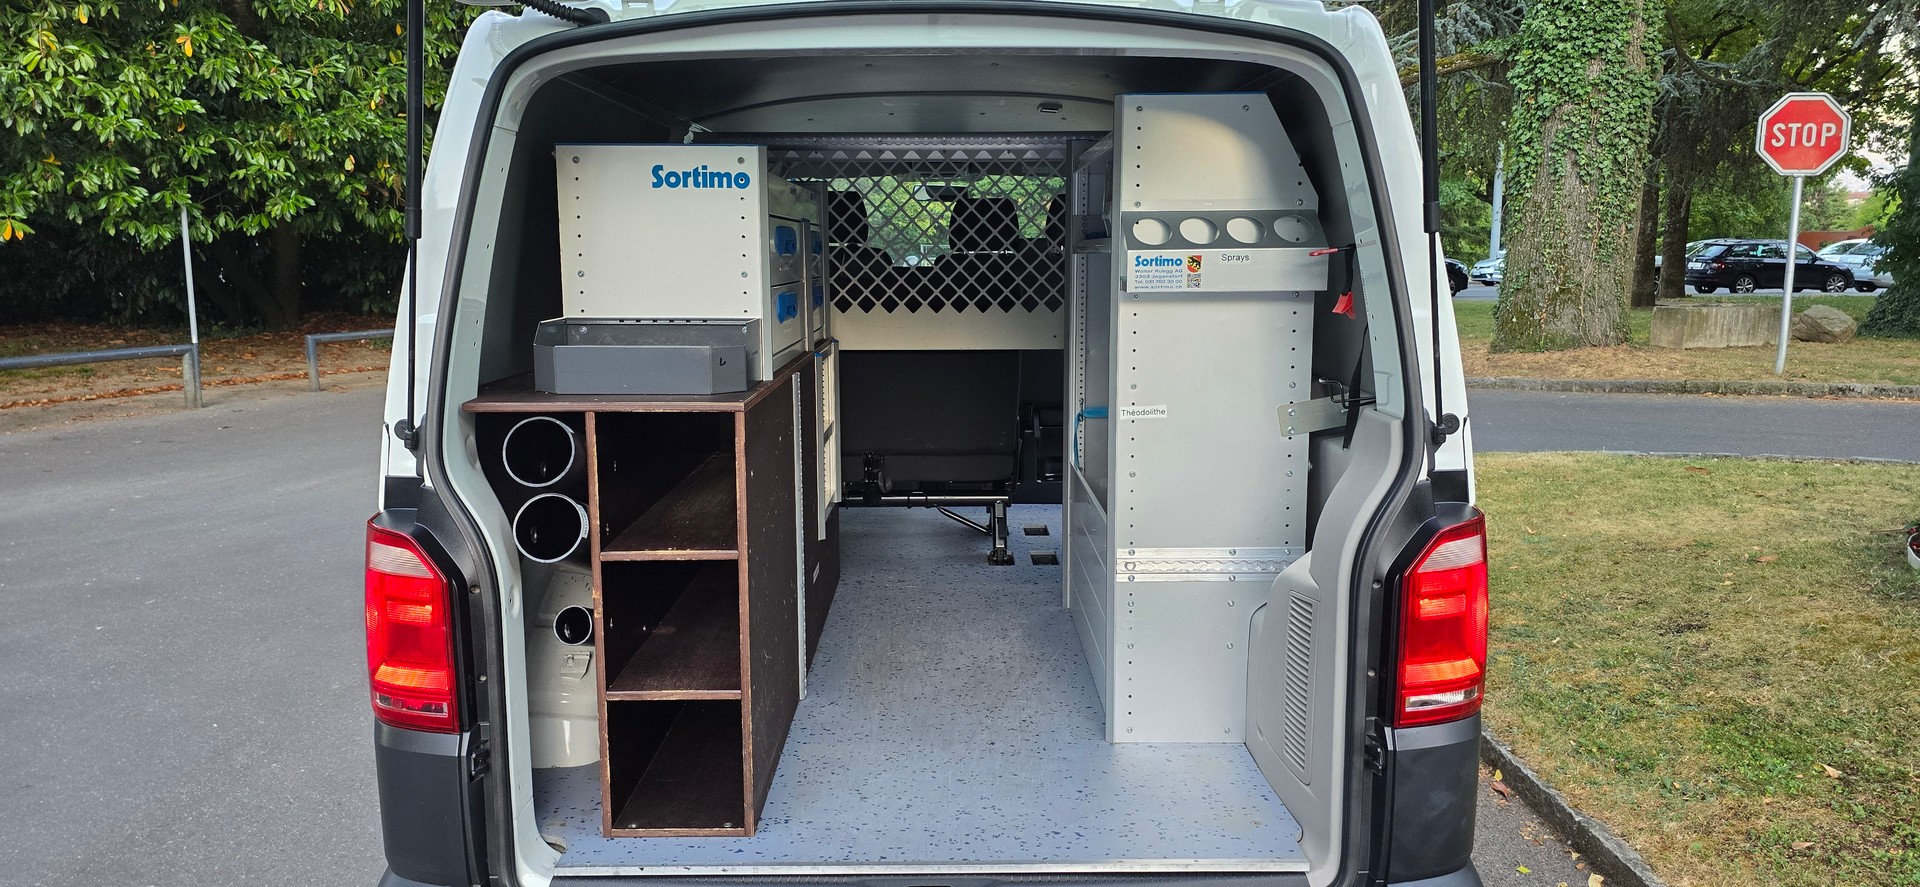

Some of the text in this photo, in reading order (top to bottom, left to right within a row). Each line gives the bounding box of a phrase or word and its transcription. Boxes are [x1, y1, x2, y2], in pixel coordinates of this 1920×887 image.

[1771, 122, 1837, 147] STOP
[651, 164, 751, 190] Sortimo
[1134, 255, 1183, 267] Sortimo
[1221, 253, 1250, 263] Sprays
